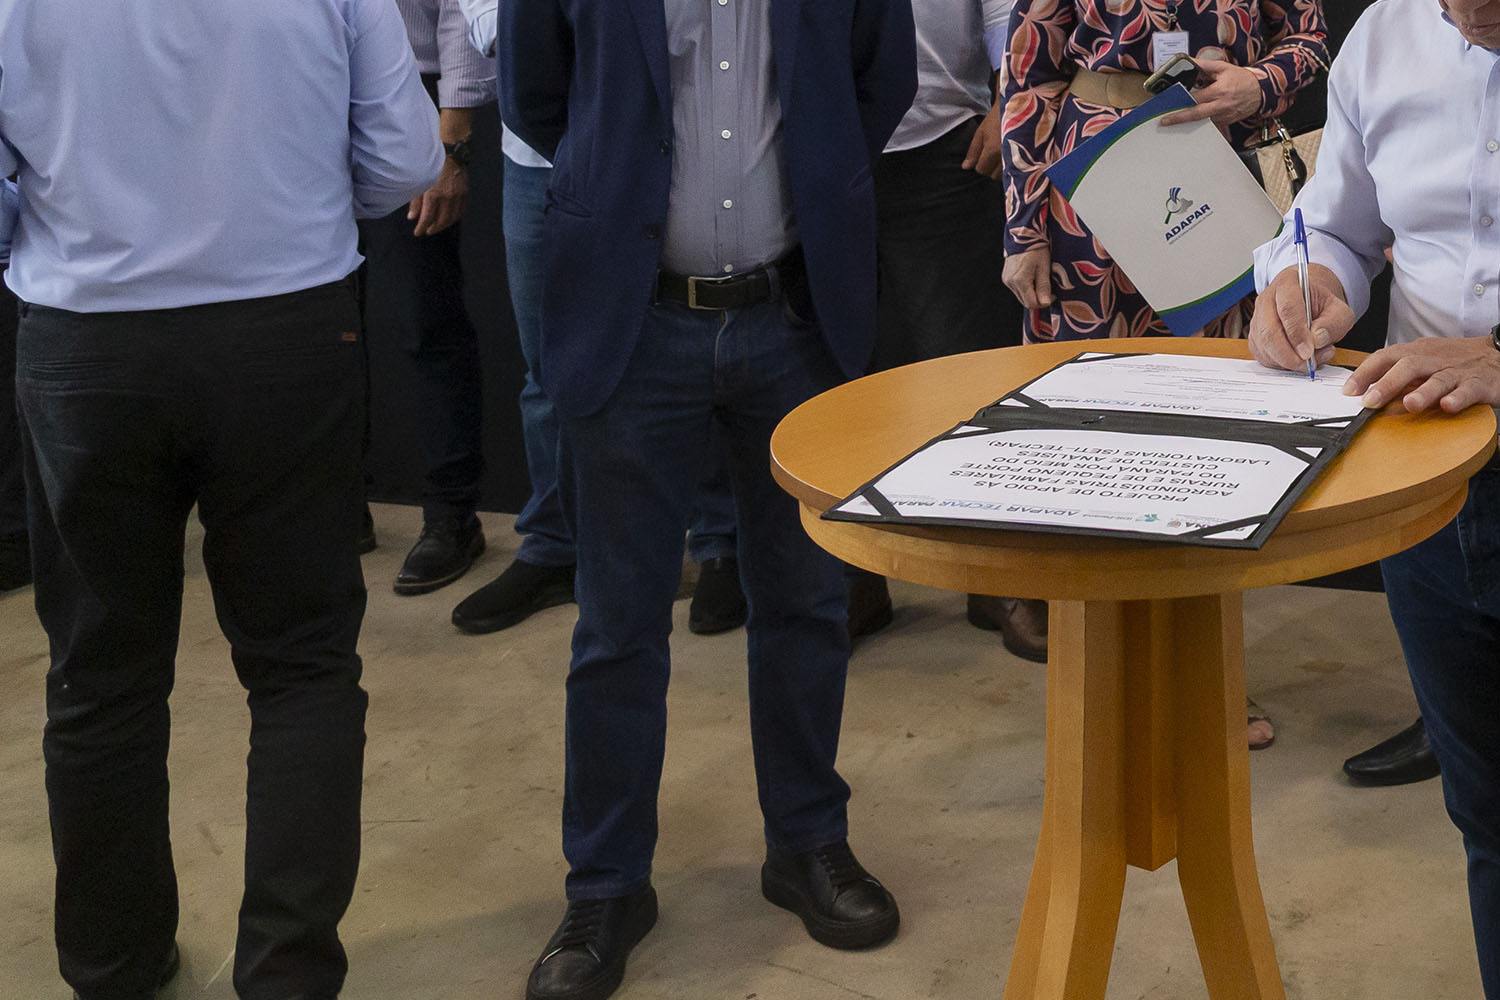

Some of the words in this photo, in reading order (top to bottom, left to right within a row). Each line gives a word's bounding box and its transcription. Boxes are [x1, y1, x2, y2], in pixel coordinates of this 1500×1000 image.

[1165, 203, 1211, 241] ADAPAR
[992, 456, 1020, 464] DO
[1016, 450, 1107, 462] ANÁLISES
[1123, 450, 1271, 466] LABORATORIAIS
[960, 462, 1024, 473] PORTE
[1023, 459, 1070, 468] MEIO
[1073, 462, 1113, 471] POR
[1139, 459, 1219, 470] CUSTEIO
[1027, 467, 1118, 480] PEQUENO
[1119, 465, 1195, 477] PARANÁ
[950, 470, 1061, 485] FAMILIARES
[1122, 474, 1148, 482] DE
[1170, 477, 1241, 489] RURAIS
[1004, 483, 1065, 493] APOIO
[1067, 488, 1095, 496] DE
[1099, 489, 1189, 502] PROJETO
[938, 500, 1002, 511] TECPAR
[1006, 505, 1079, 517] ADAPAR
